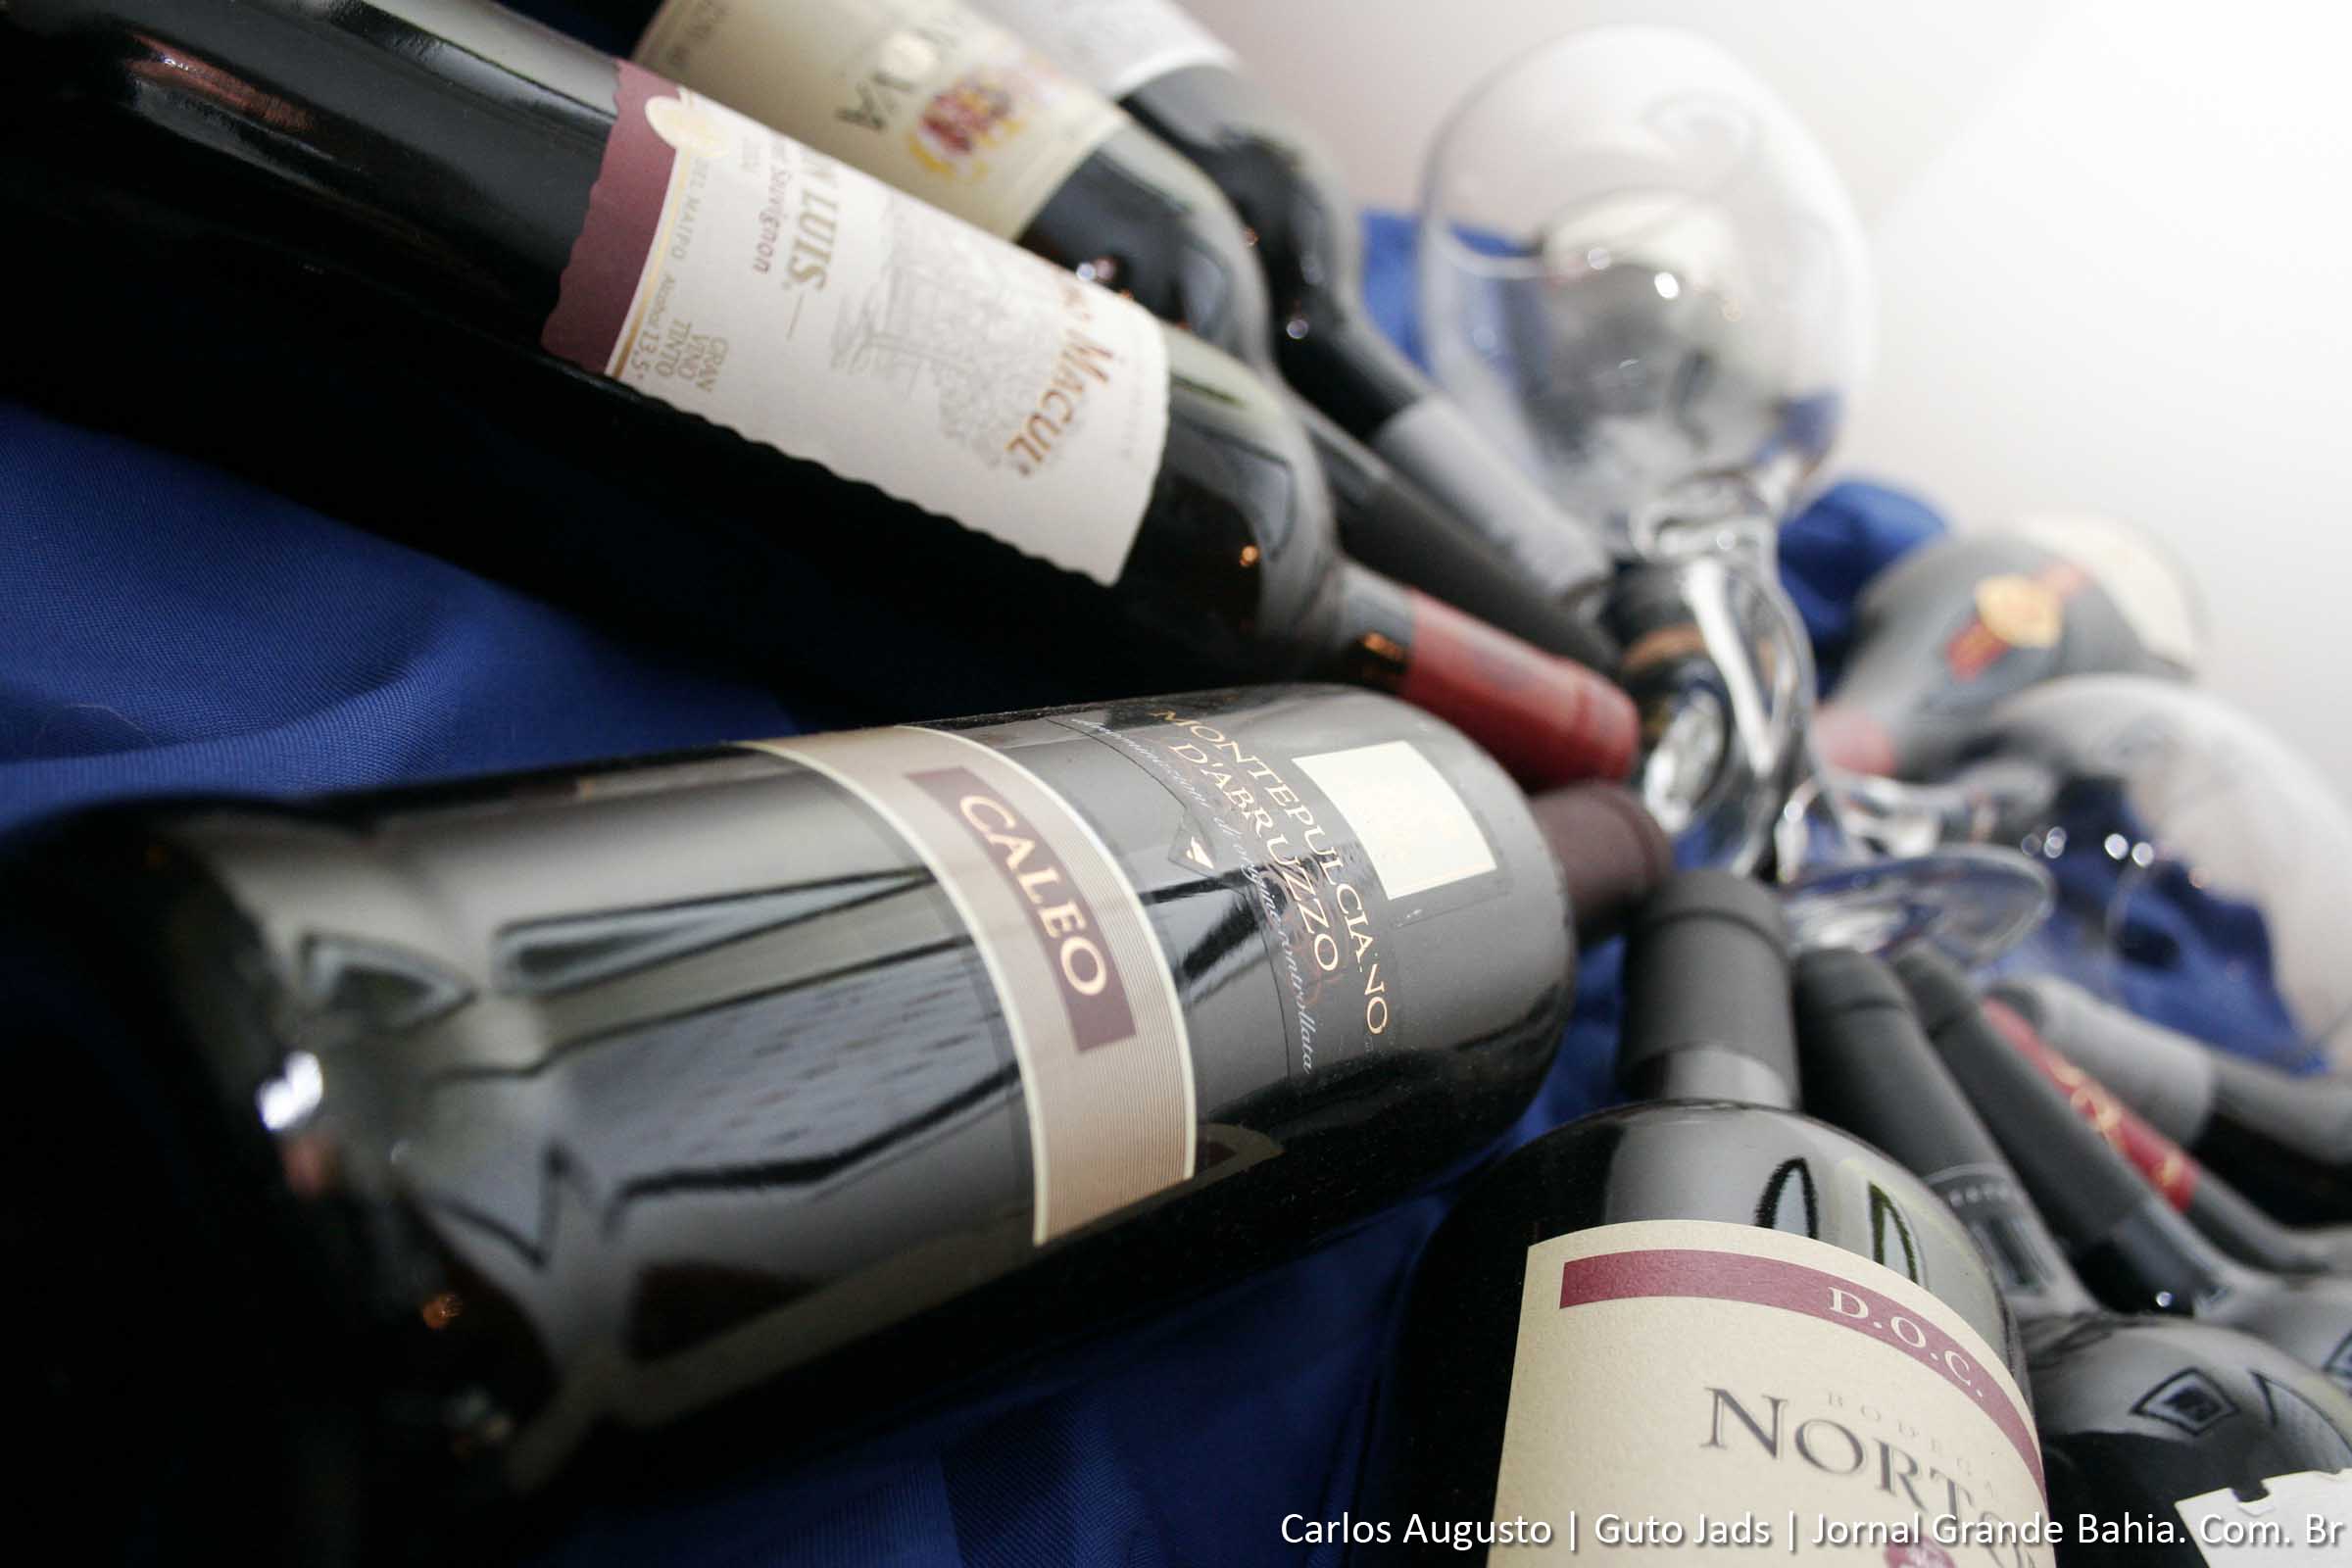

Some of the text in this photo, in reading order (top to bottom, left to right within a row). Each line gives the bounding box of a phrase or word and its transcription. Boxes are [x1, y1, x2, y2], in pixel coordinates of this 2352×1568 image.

[655, 319, 693, 378] TINTO
[959, 795, 1107, 996] CALEO
[1147, 710, 1388, 1035] MONTEPULCIANO
[1168, 742, 1339, 971] D'ABRUZZO
[1828, 1287, 1984, 1398] D.O.C.
